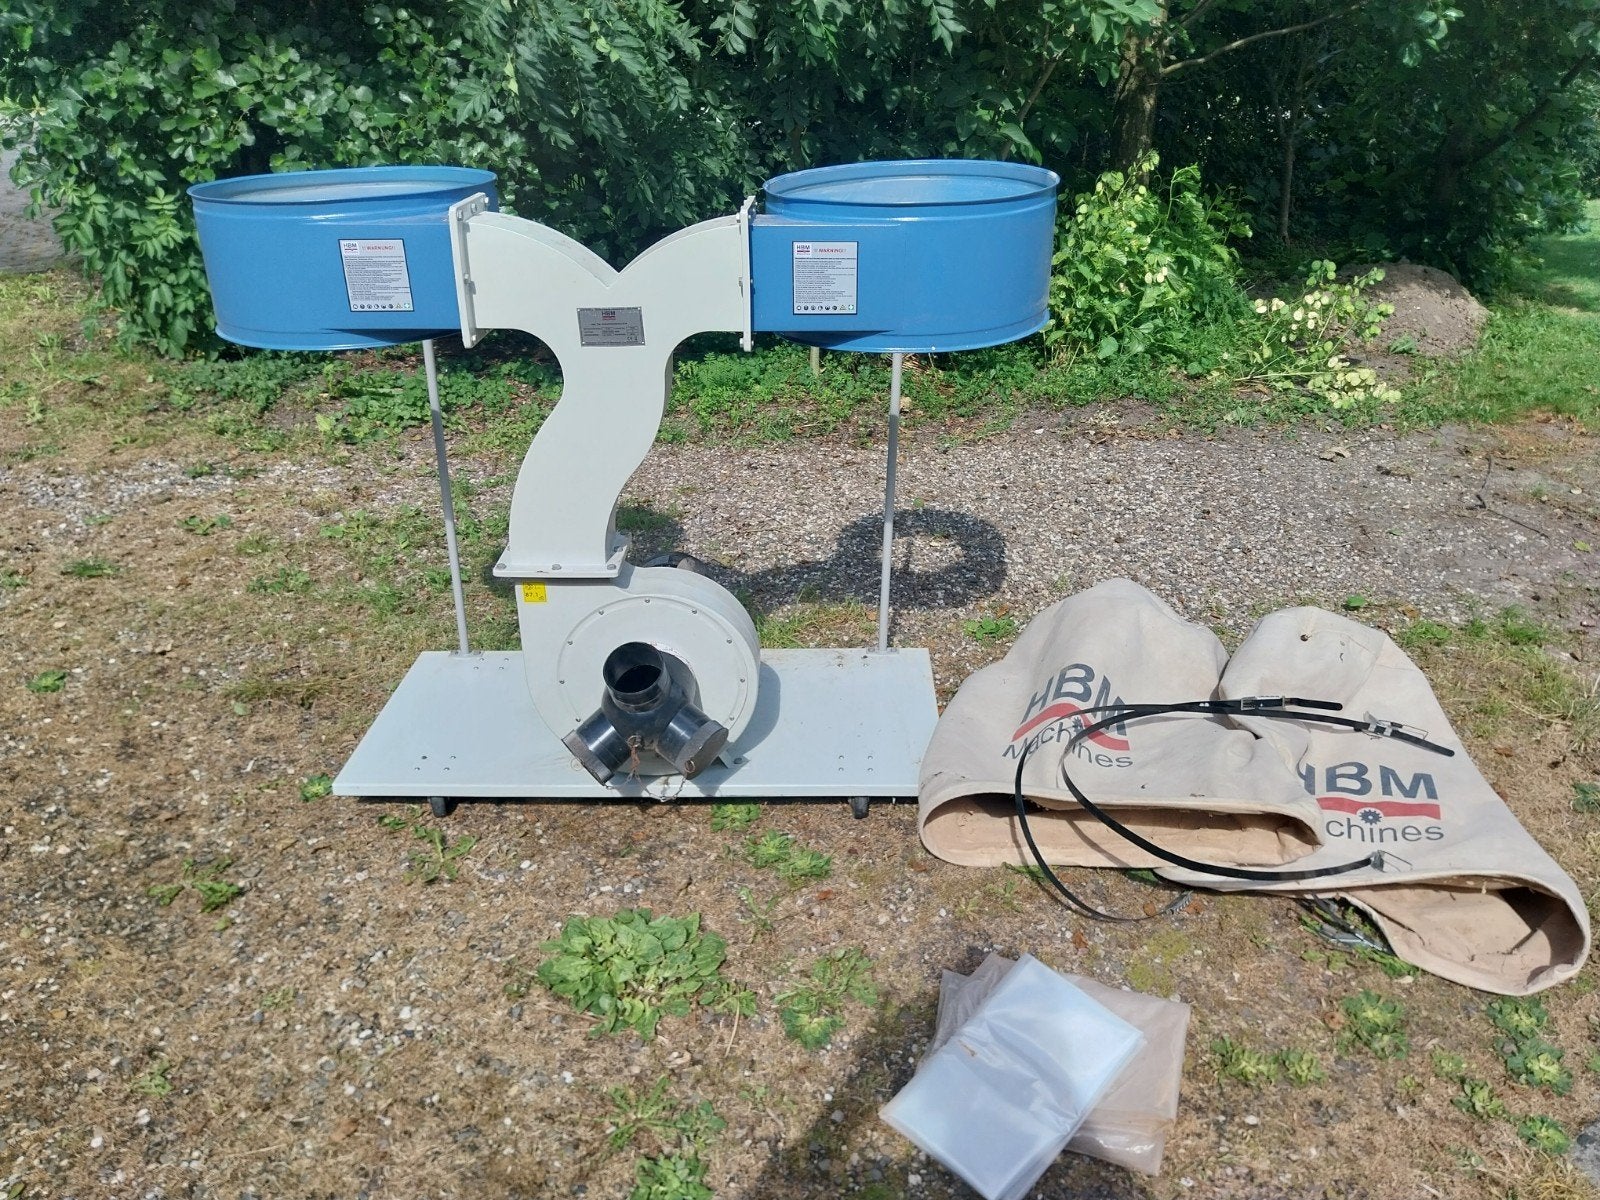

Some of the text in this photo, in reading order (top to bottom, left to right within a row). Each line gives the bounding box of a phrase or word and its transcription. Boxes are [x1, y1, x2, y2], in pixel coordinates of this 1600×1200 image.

[1020, 663, 1127, 736] HBM
[1001, 721, 1134, 768] Machines
[1325, 817, 1445, 843] chines
